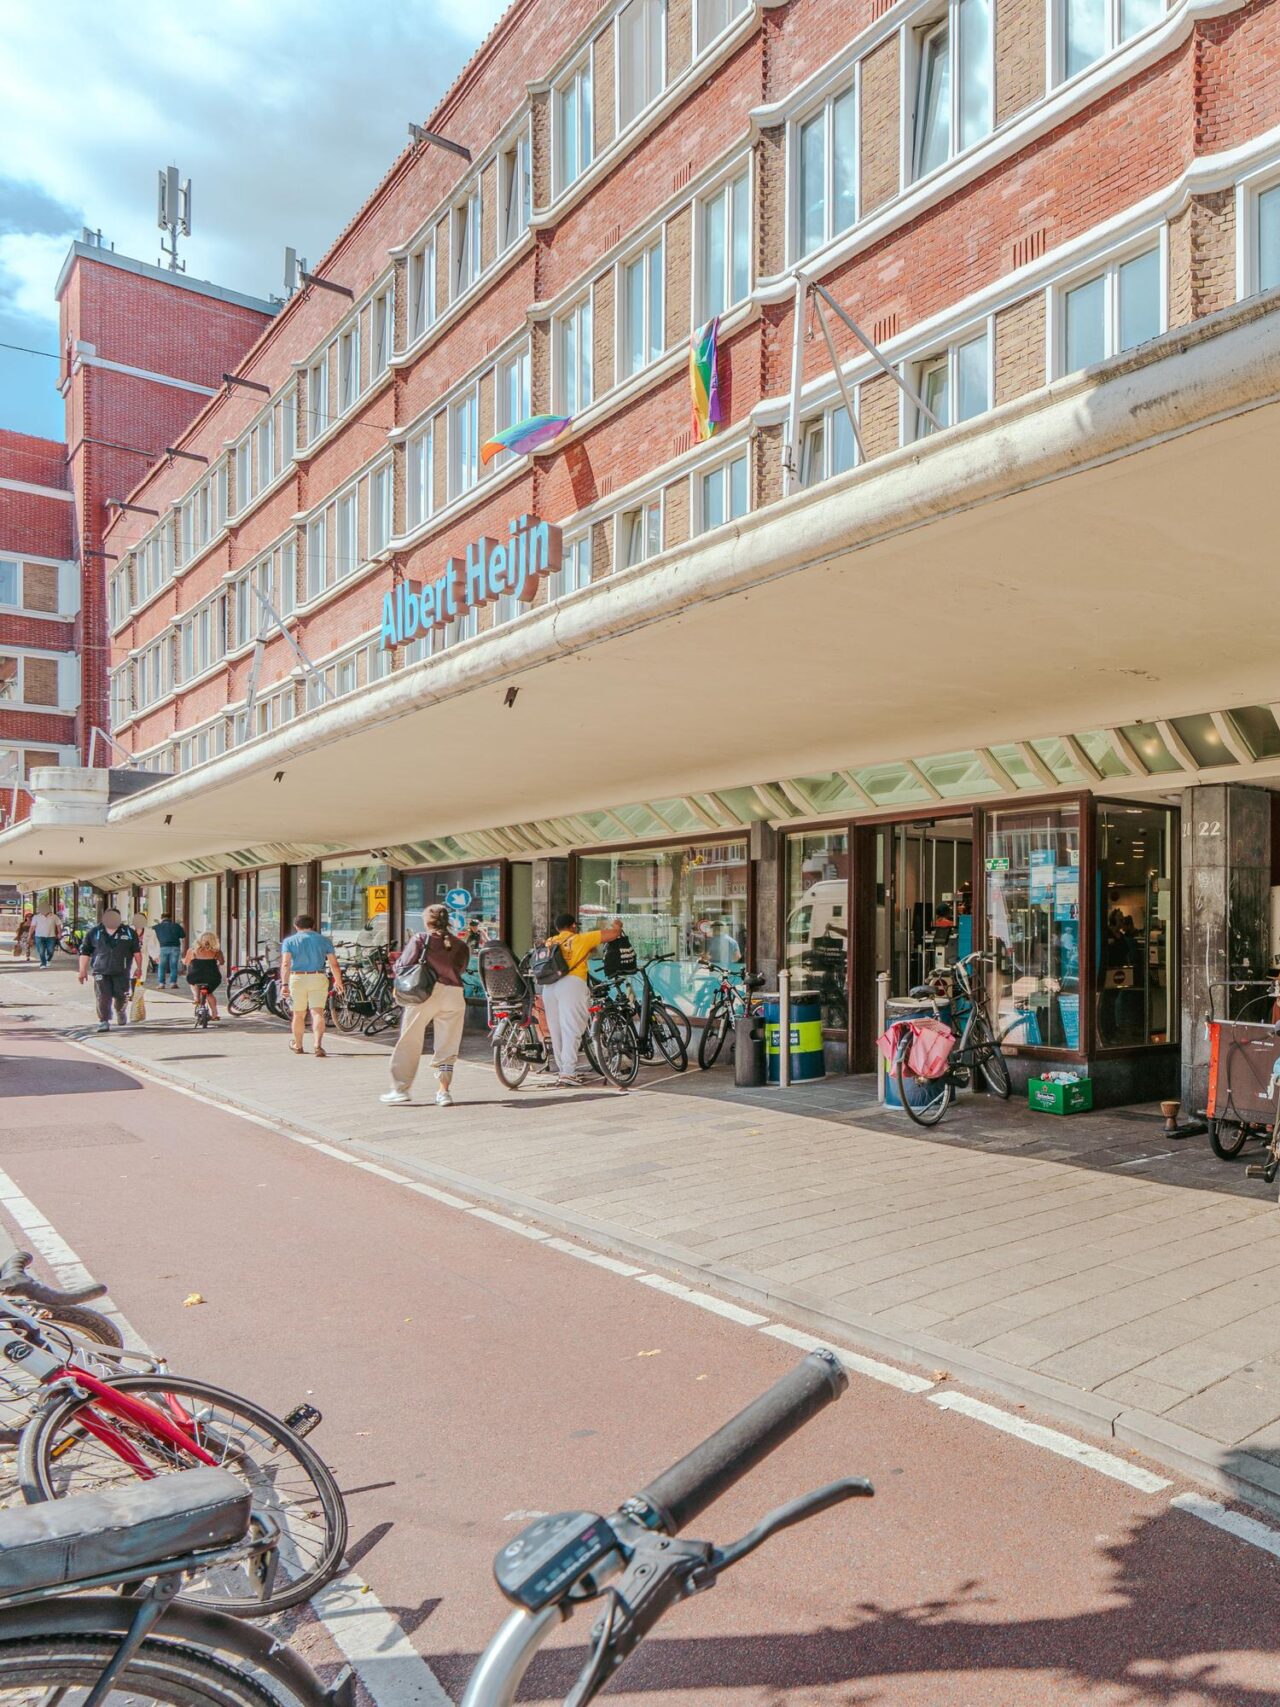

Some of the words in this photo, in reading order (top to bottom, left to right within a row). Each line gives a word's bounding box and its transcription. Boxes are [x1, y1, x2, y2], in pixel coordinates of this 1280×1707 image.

[380, 558, 457, 651] Albert
[466, 514, 549, 606] Heijn
[1198, 821, 1221, 836] 22
